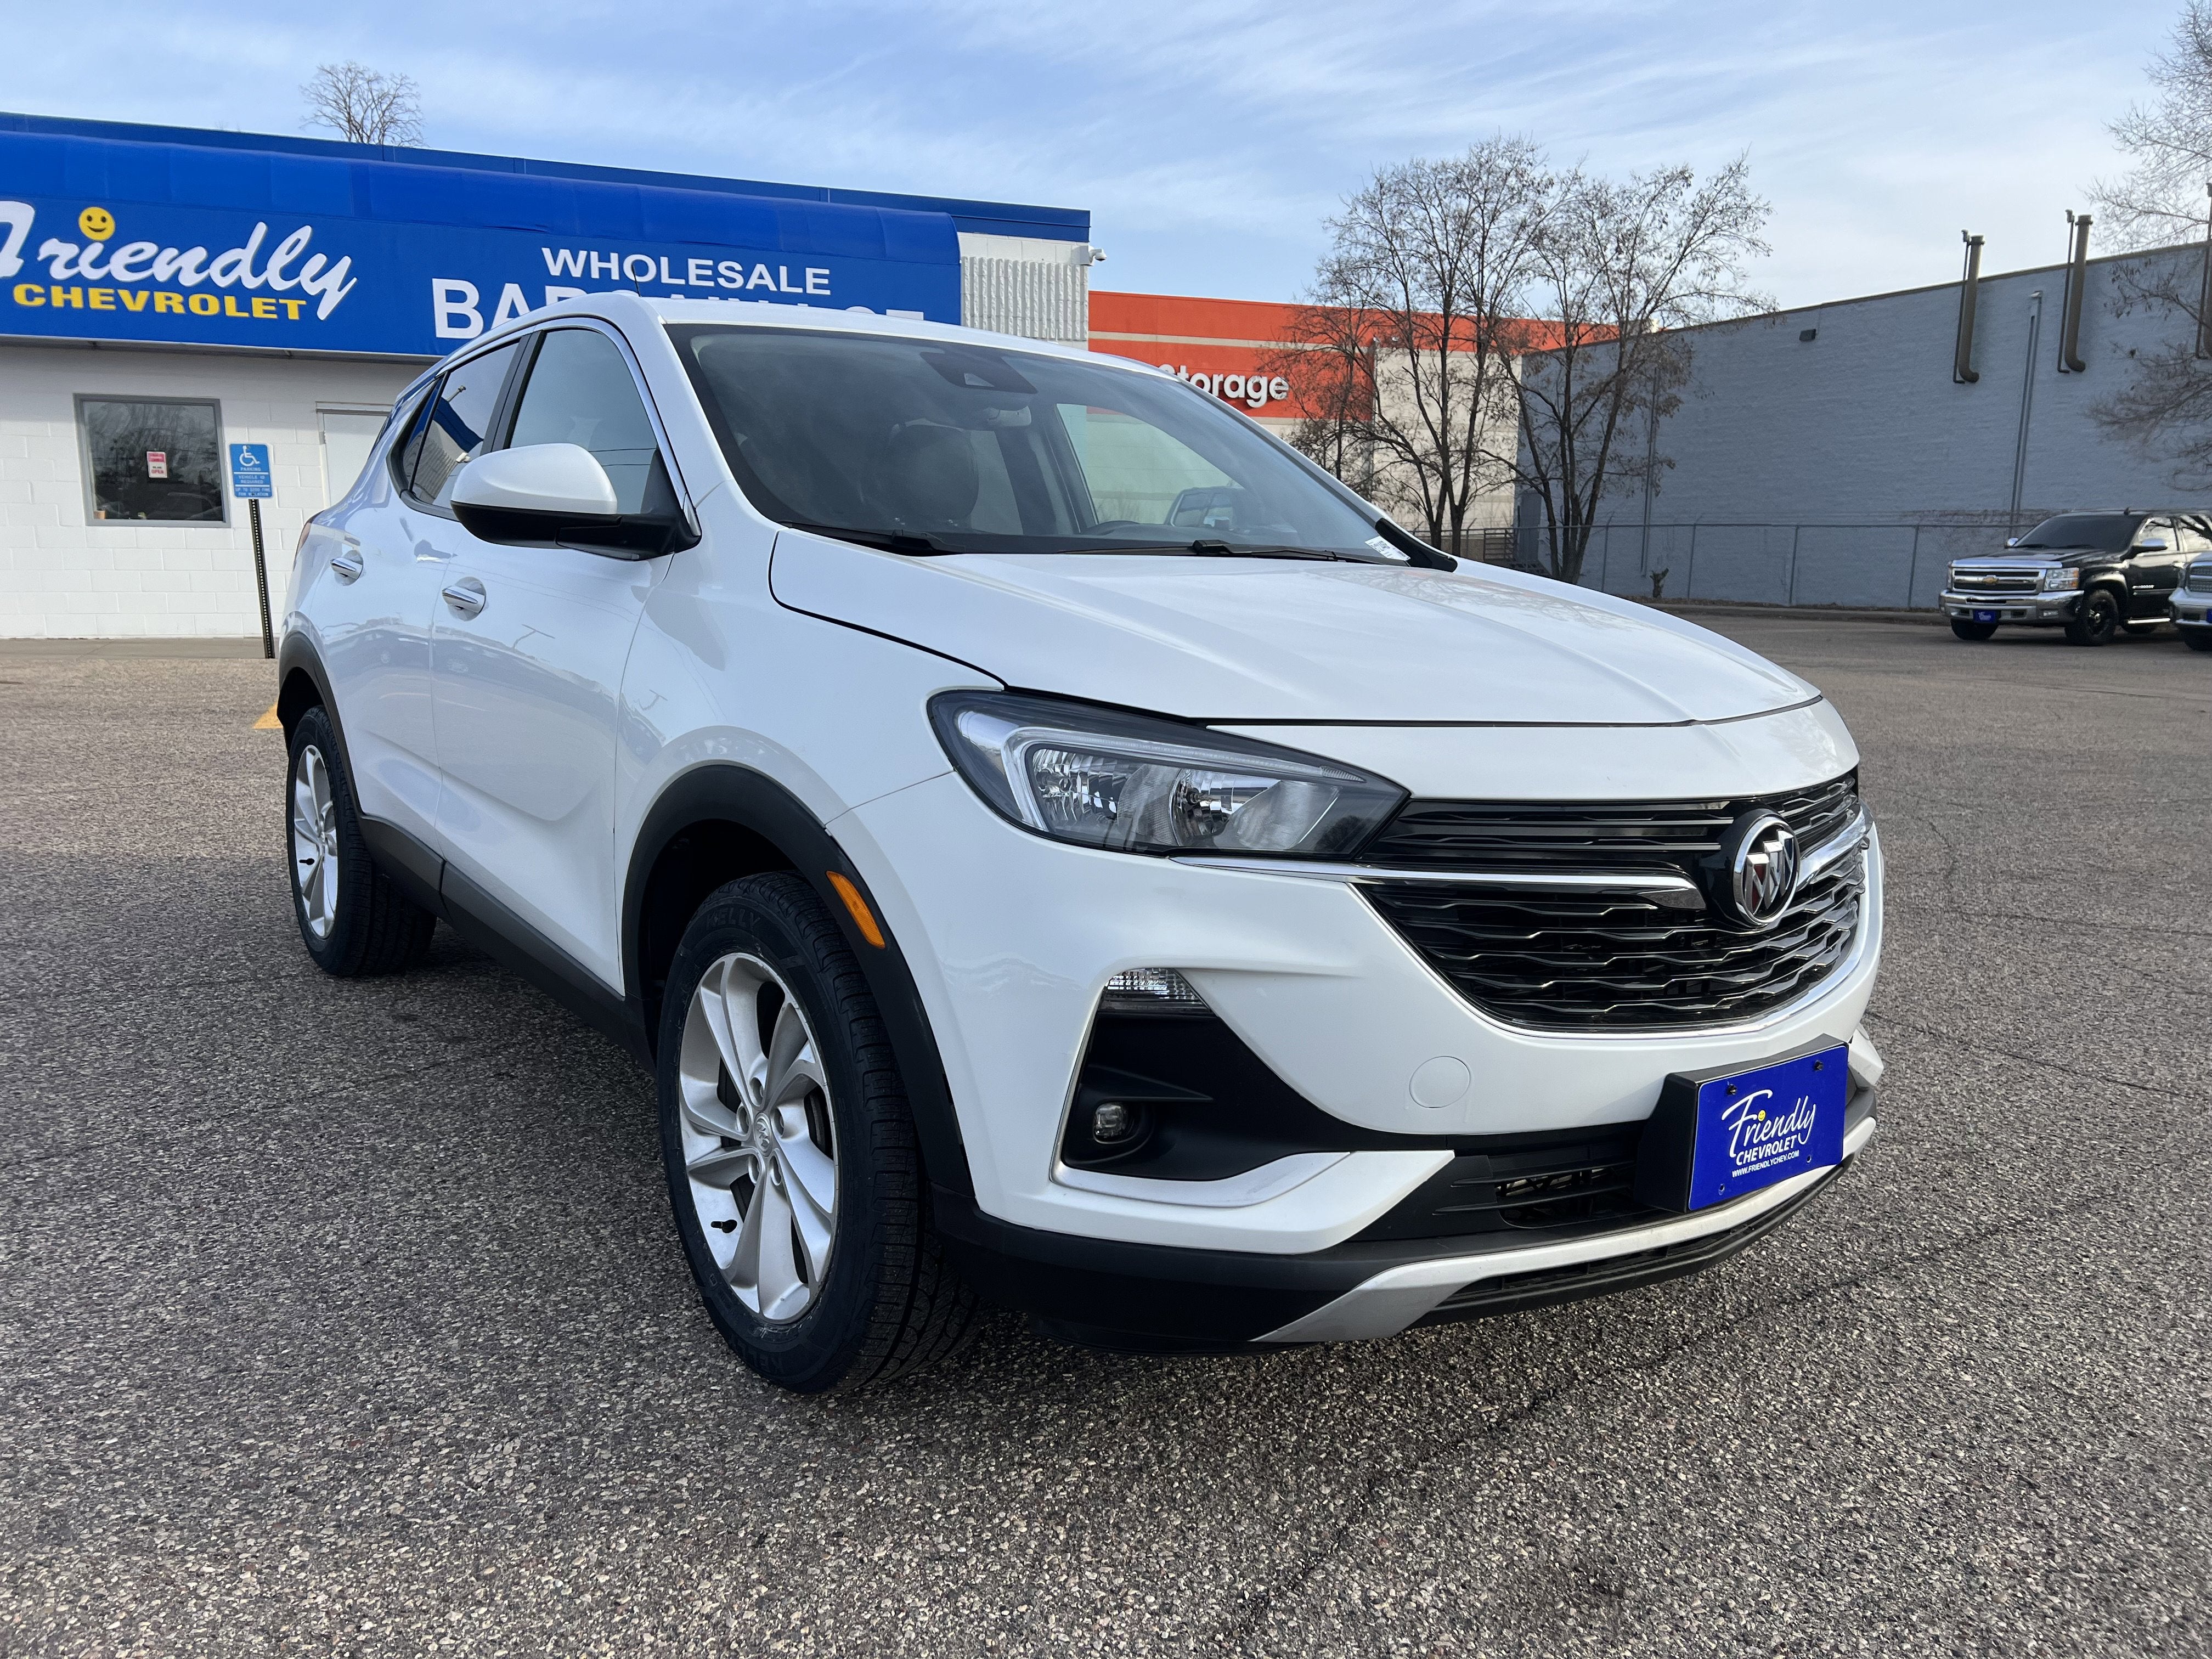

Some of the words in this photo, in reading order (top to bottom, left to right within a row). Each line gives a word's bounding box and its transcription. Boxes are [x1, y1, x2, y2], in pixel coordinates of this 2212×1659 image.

[541, 247, 831, 295] WHOLESALE
[13, 283, 306, 320] CHEVROLET
[706, 907, 761, 932] KELLY
[1722, 1089, 1816, 1158] Friendly
[1732, 1149, 1800, 1178] WWW.FRIENDLYCHEV.COM
[1735, 1133, 1797, 1166] CHEVROLET
